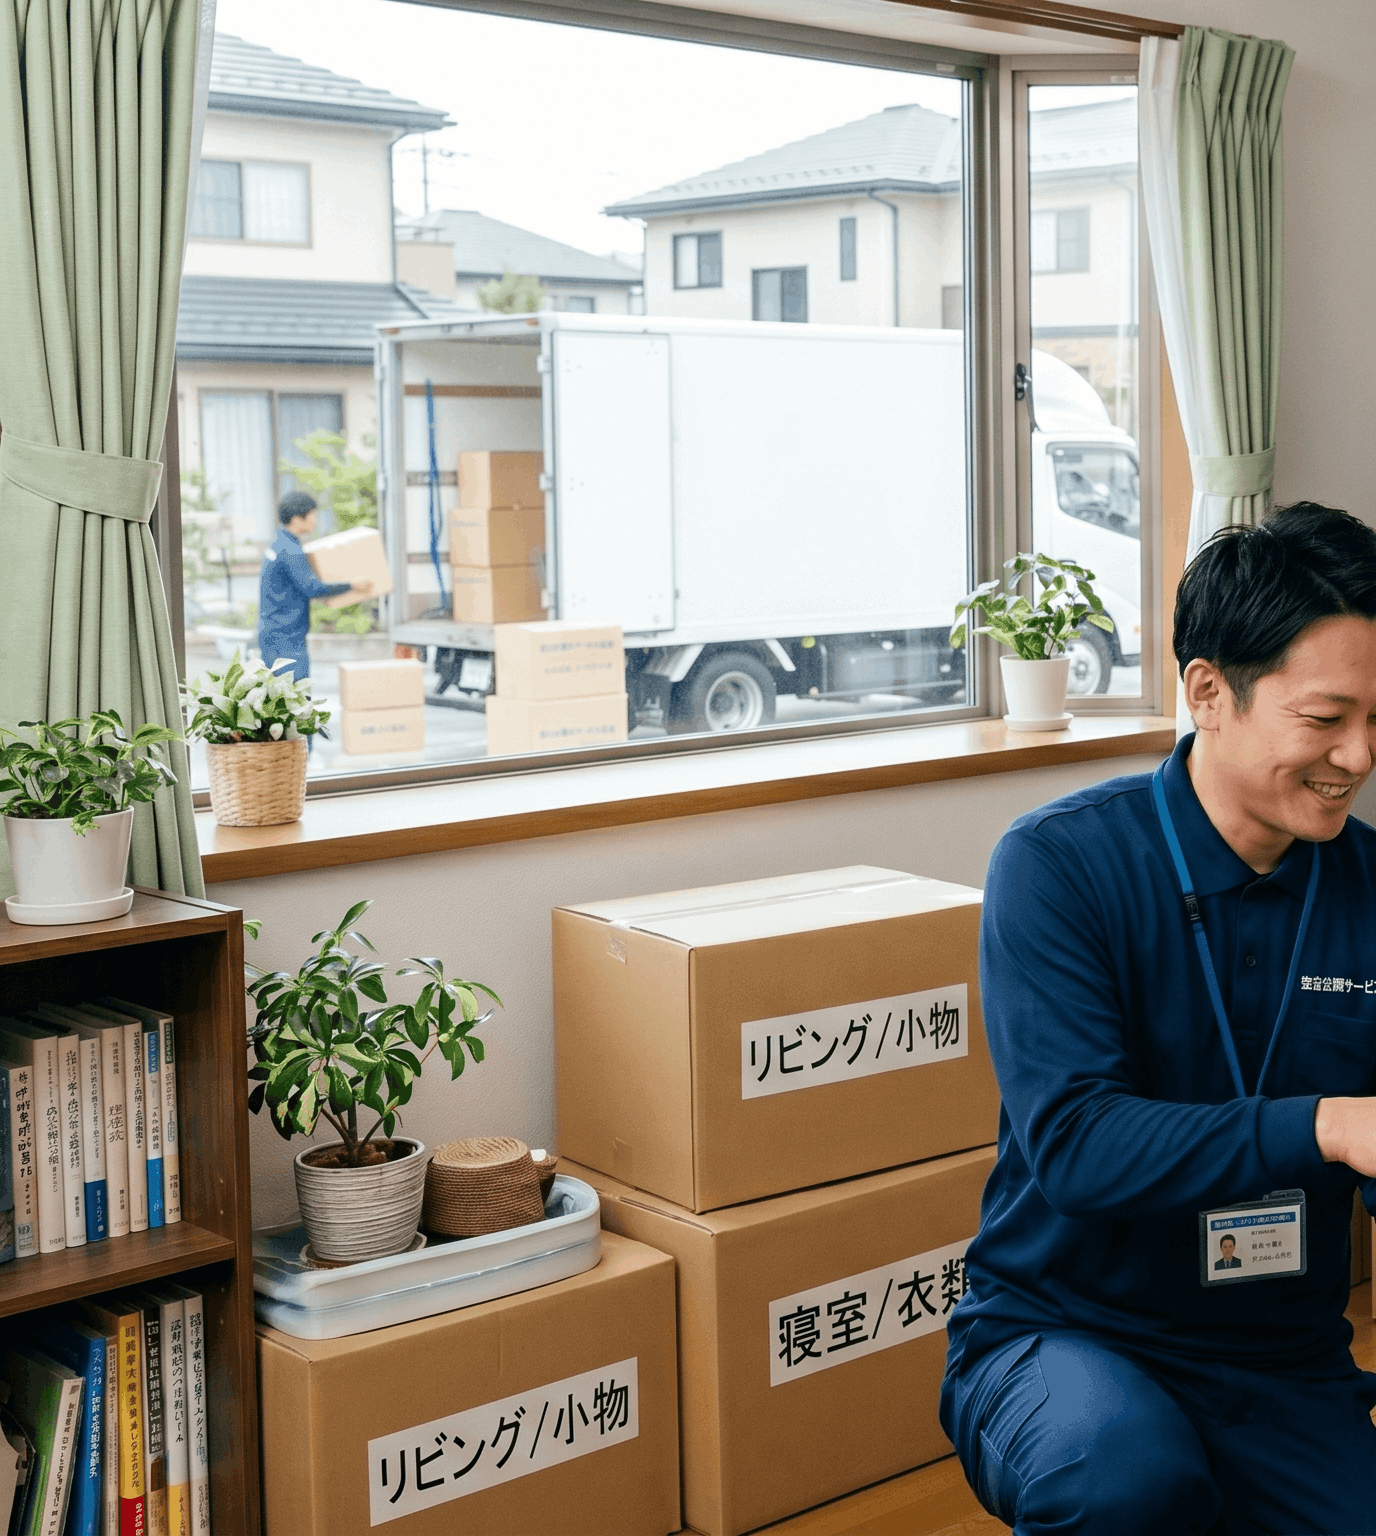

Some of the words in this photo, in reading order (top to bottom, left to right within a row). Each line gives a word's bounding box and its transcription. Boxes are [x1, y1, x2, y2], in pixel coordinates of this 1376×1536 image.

[750, 1000, 960, 1083] リビング/小物
[380, 1378, 629, 1505] リビング/小物
